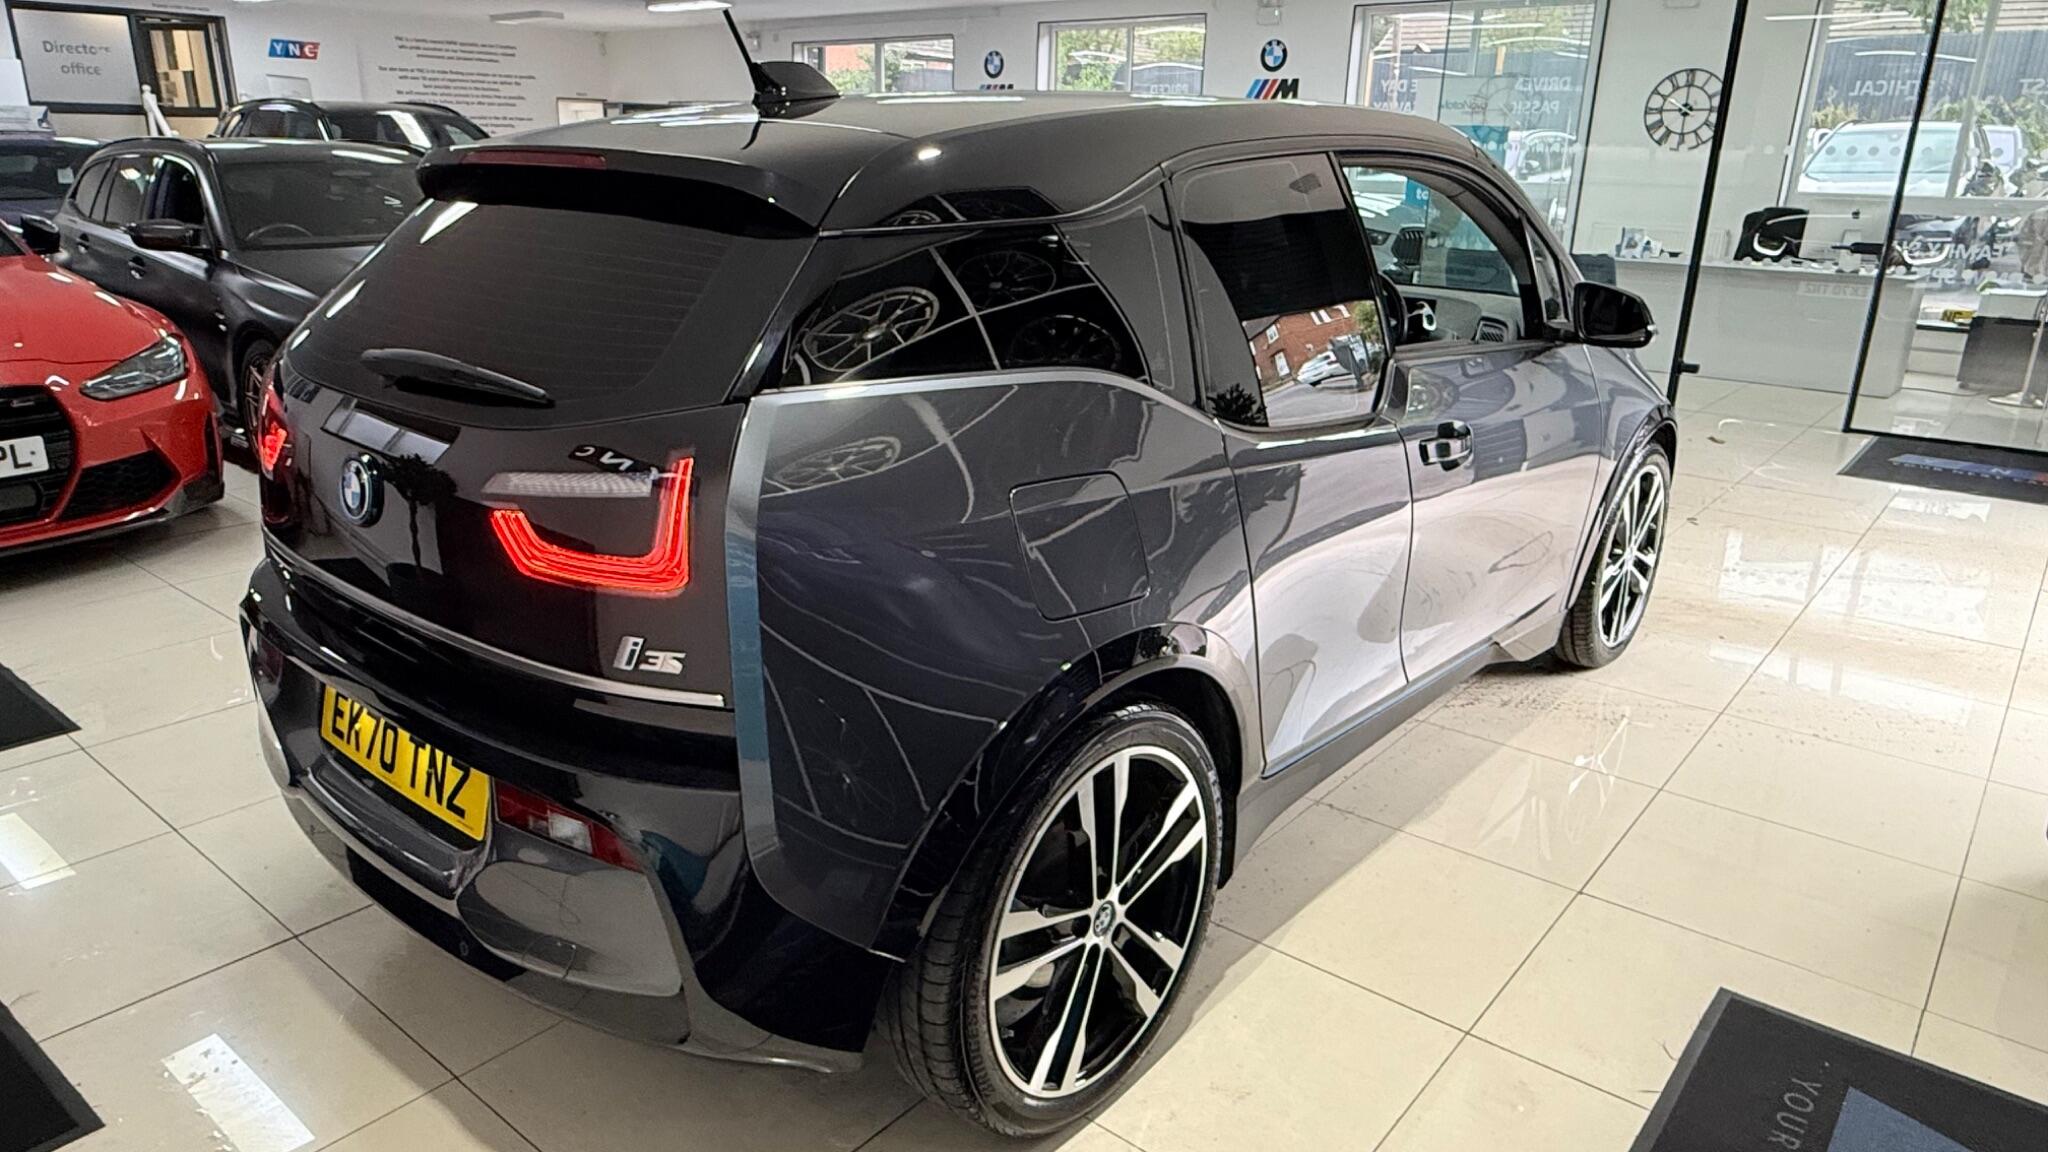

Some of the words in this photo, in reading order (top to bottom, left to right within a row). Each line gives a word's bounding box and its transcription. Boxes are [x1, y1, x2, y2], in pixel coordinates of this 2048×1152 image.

[61, 62, 103, 76] office
[271, 40, 316, 58] YNC
[332, 692, 399, 775] EK70
[409, 732, 471, 820] TNZ
[1768, 1078, 1823, 1150] YOUR
